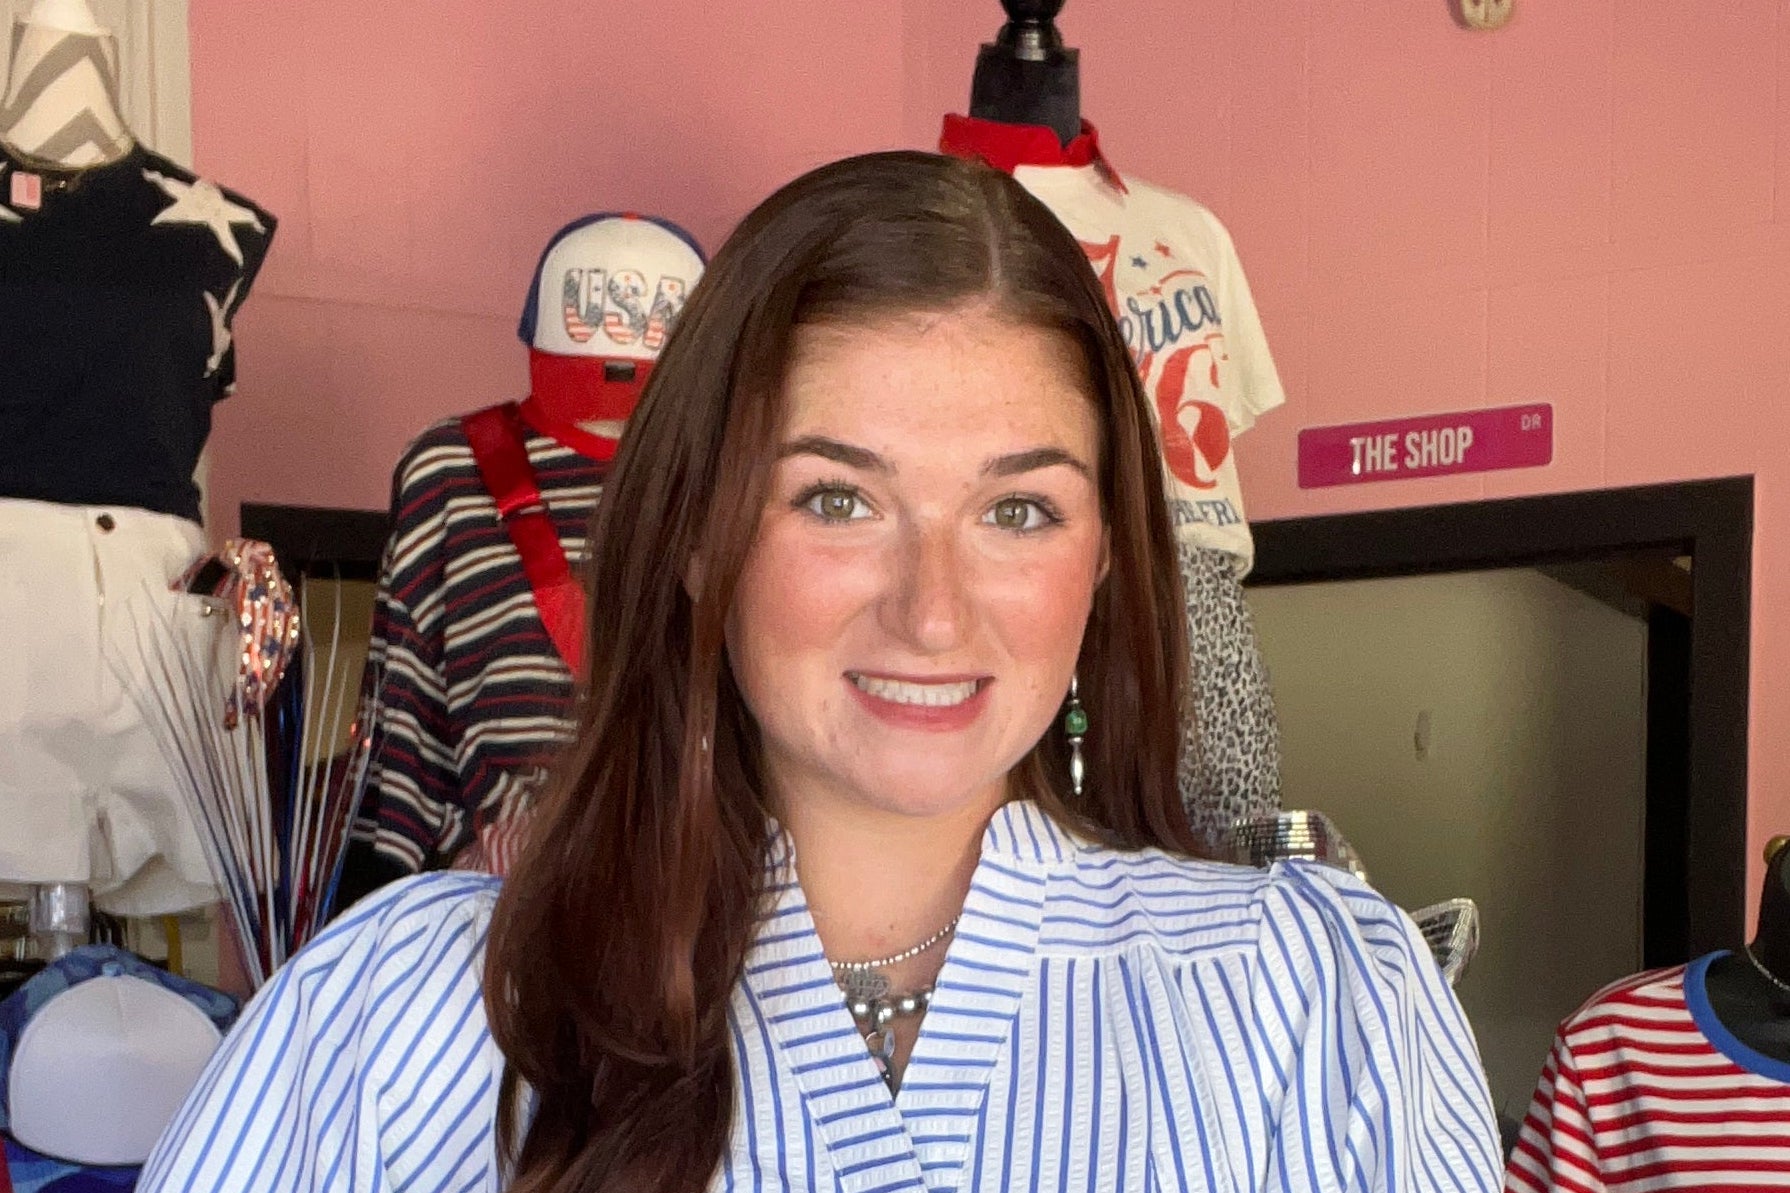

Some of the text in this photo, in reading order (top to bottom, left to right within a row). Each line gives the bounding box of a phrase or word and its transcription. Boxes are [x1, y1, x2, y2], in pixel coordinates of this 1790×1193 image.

[1118, 285, 1223, 367] erica
[1127, 343, 1231, 490] 6
[1349, 434, 1399, 476] THE
[1404, 426, 1475, 470] SHOP
